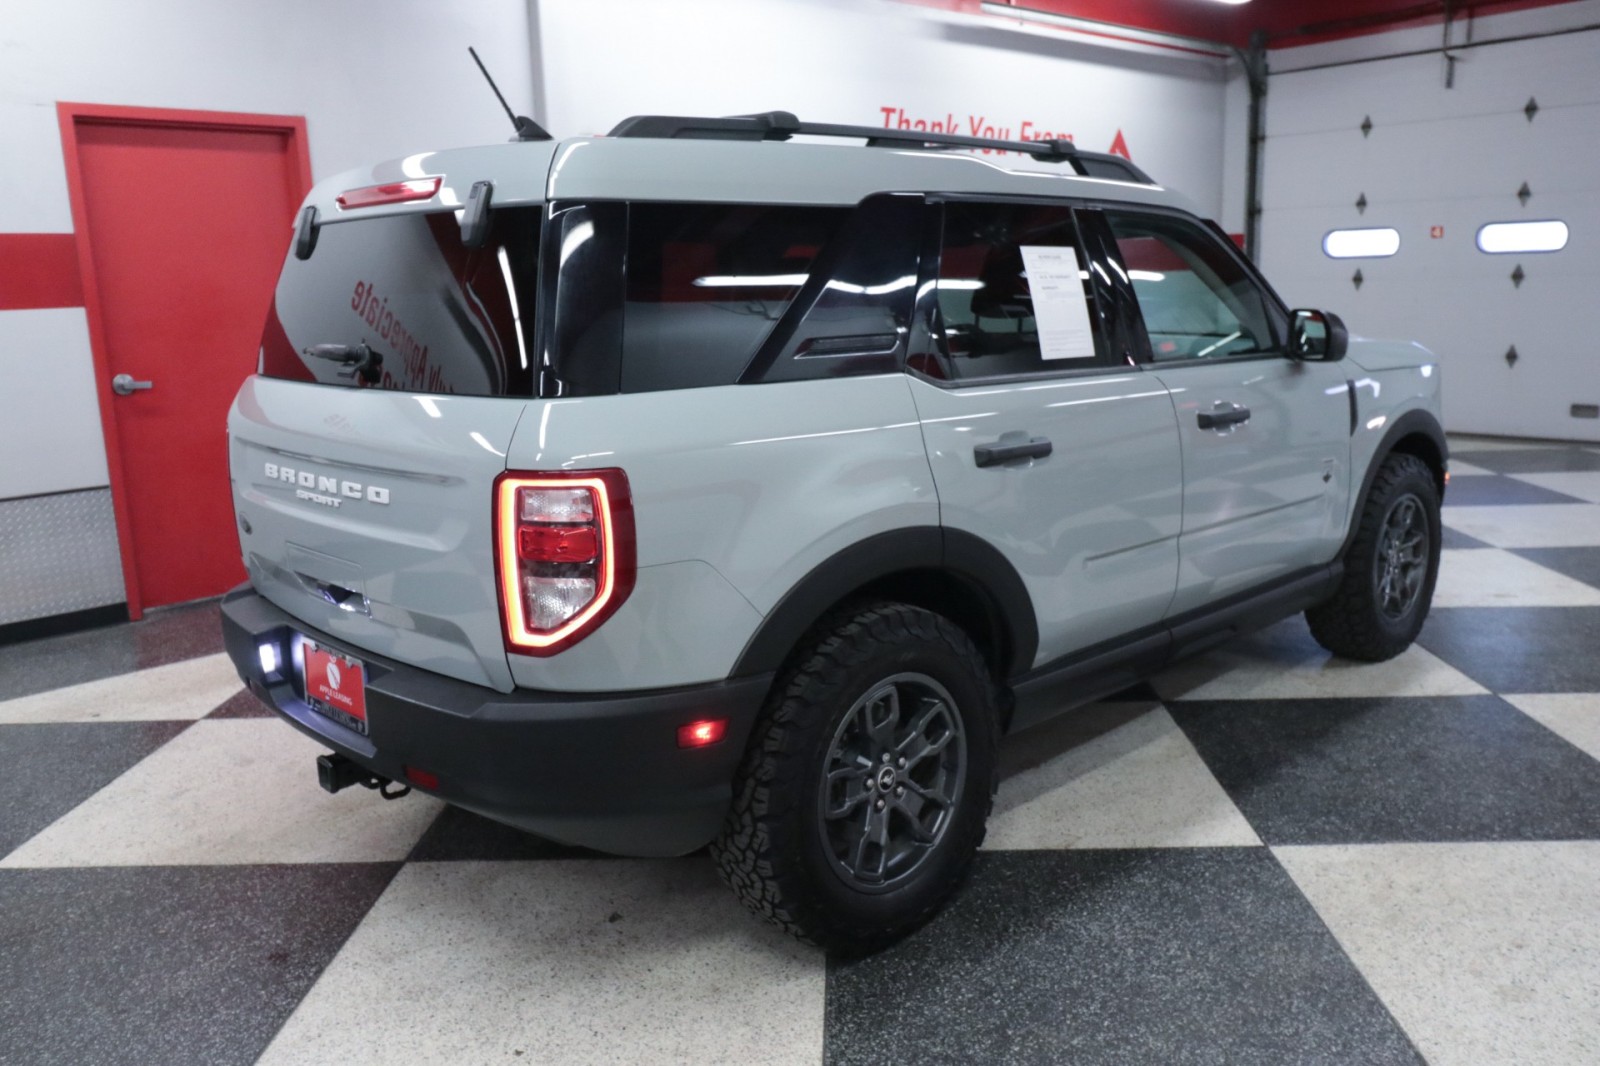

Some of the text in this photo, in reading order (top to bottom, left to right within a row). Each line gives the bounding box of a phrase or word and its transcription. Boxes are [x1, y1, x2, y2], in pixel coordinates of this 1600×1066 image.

[969, 116, 1009, 155] You
[264, 462, 390, 505] BRONCO
[296, 489, 342, 508] SPORT
